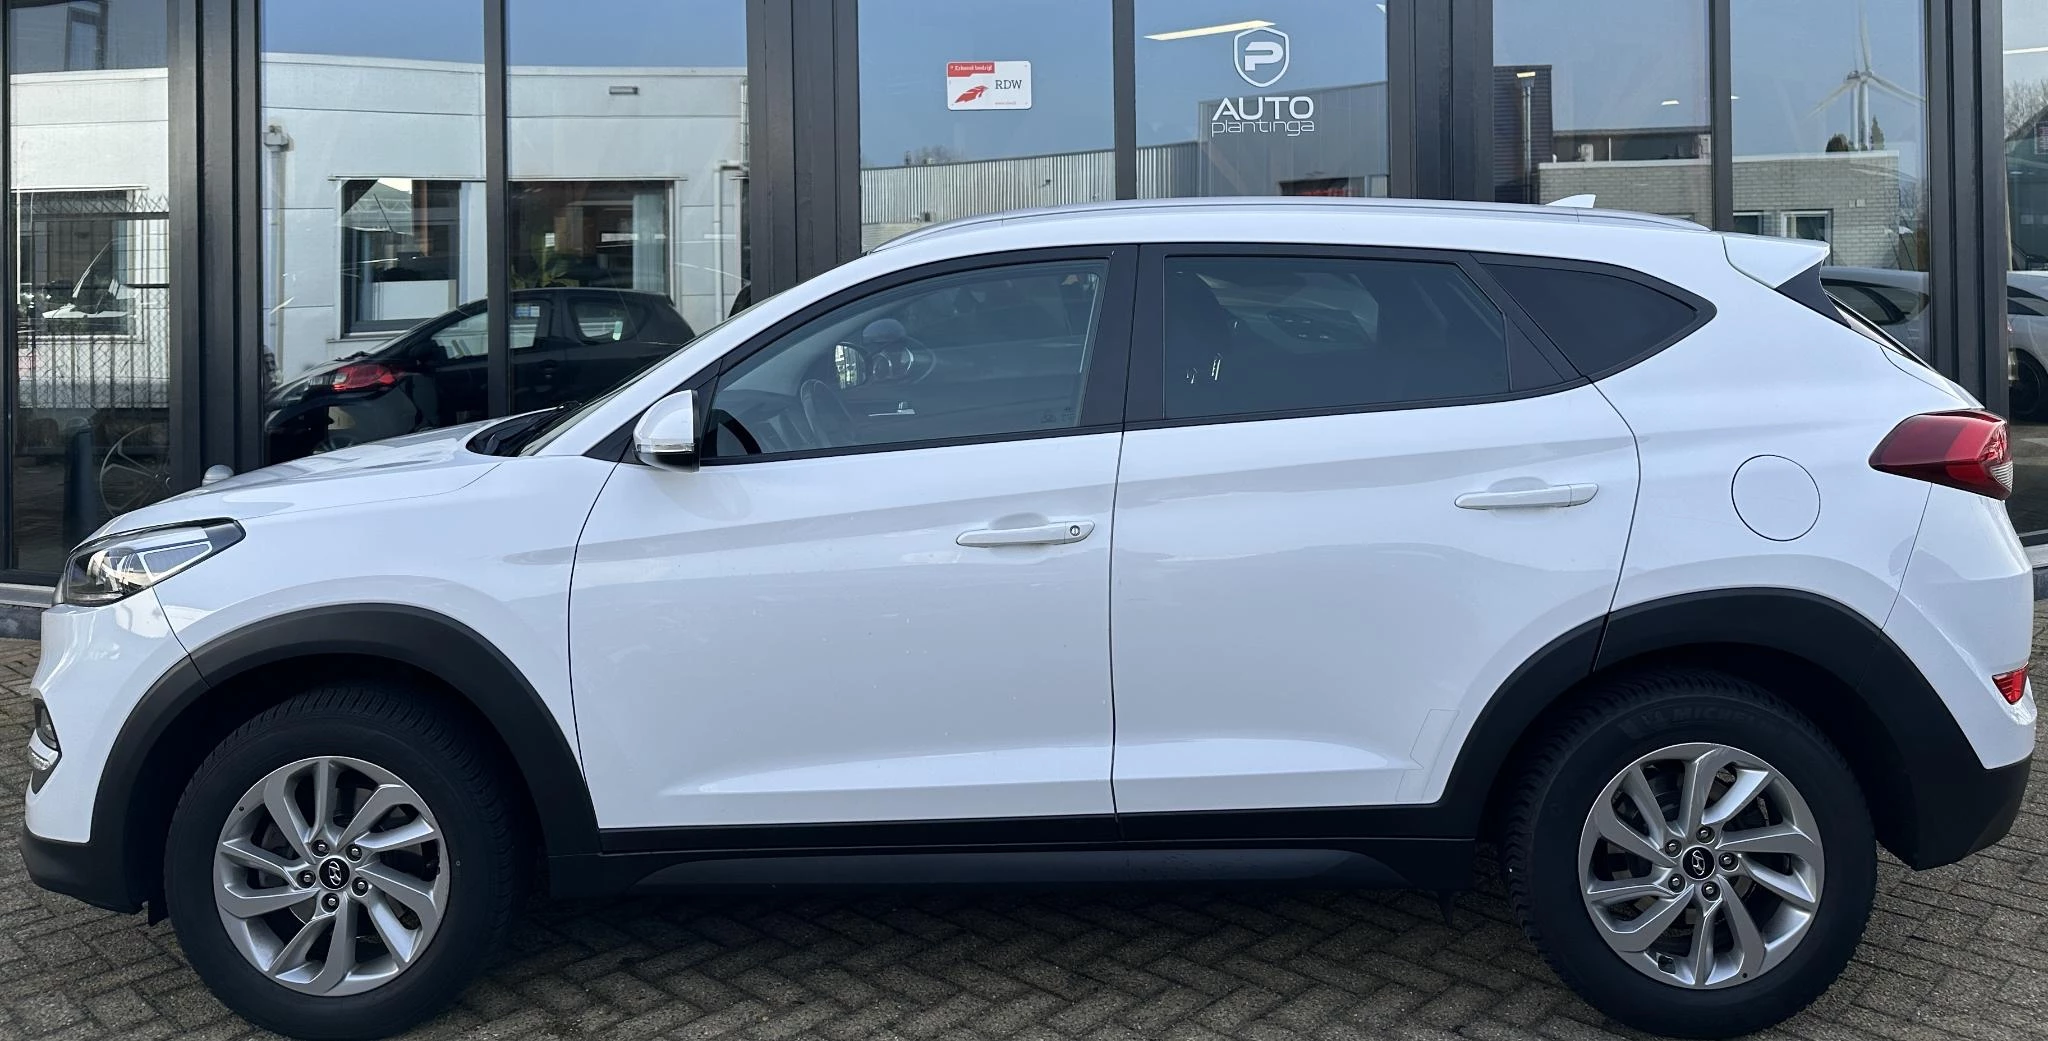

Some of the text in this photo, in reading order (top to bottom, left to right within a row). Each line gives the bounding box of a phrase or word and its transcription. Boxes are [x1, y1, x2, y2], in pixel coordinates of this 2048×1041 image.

[995, 79, 1022, 90] RDW
[1212, 96, 1314, 120] AUTO
[1211, 119, 1315, 138] plantinga
